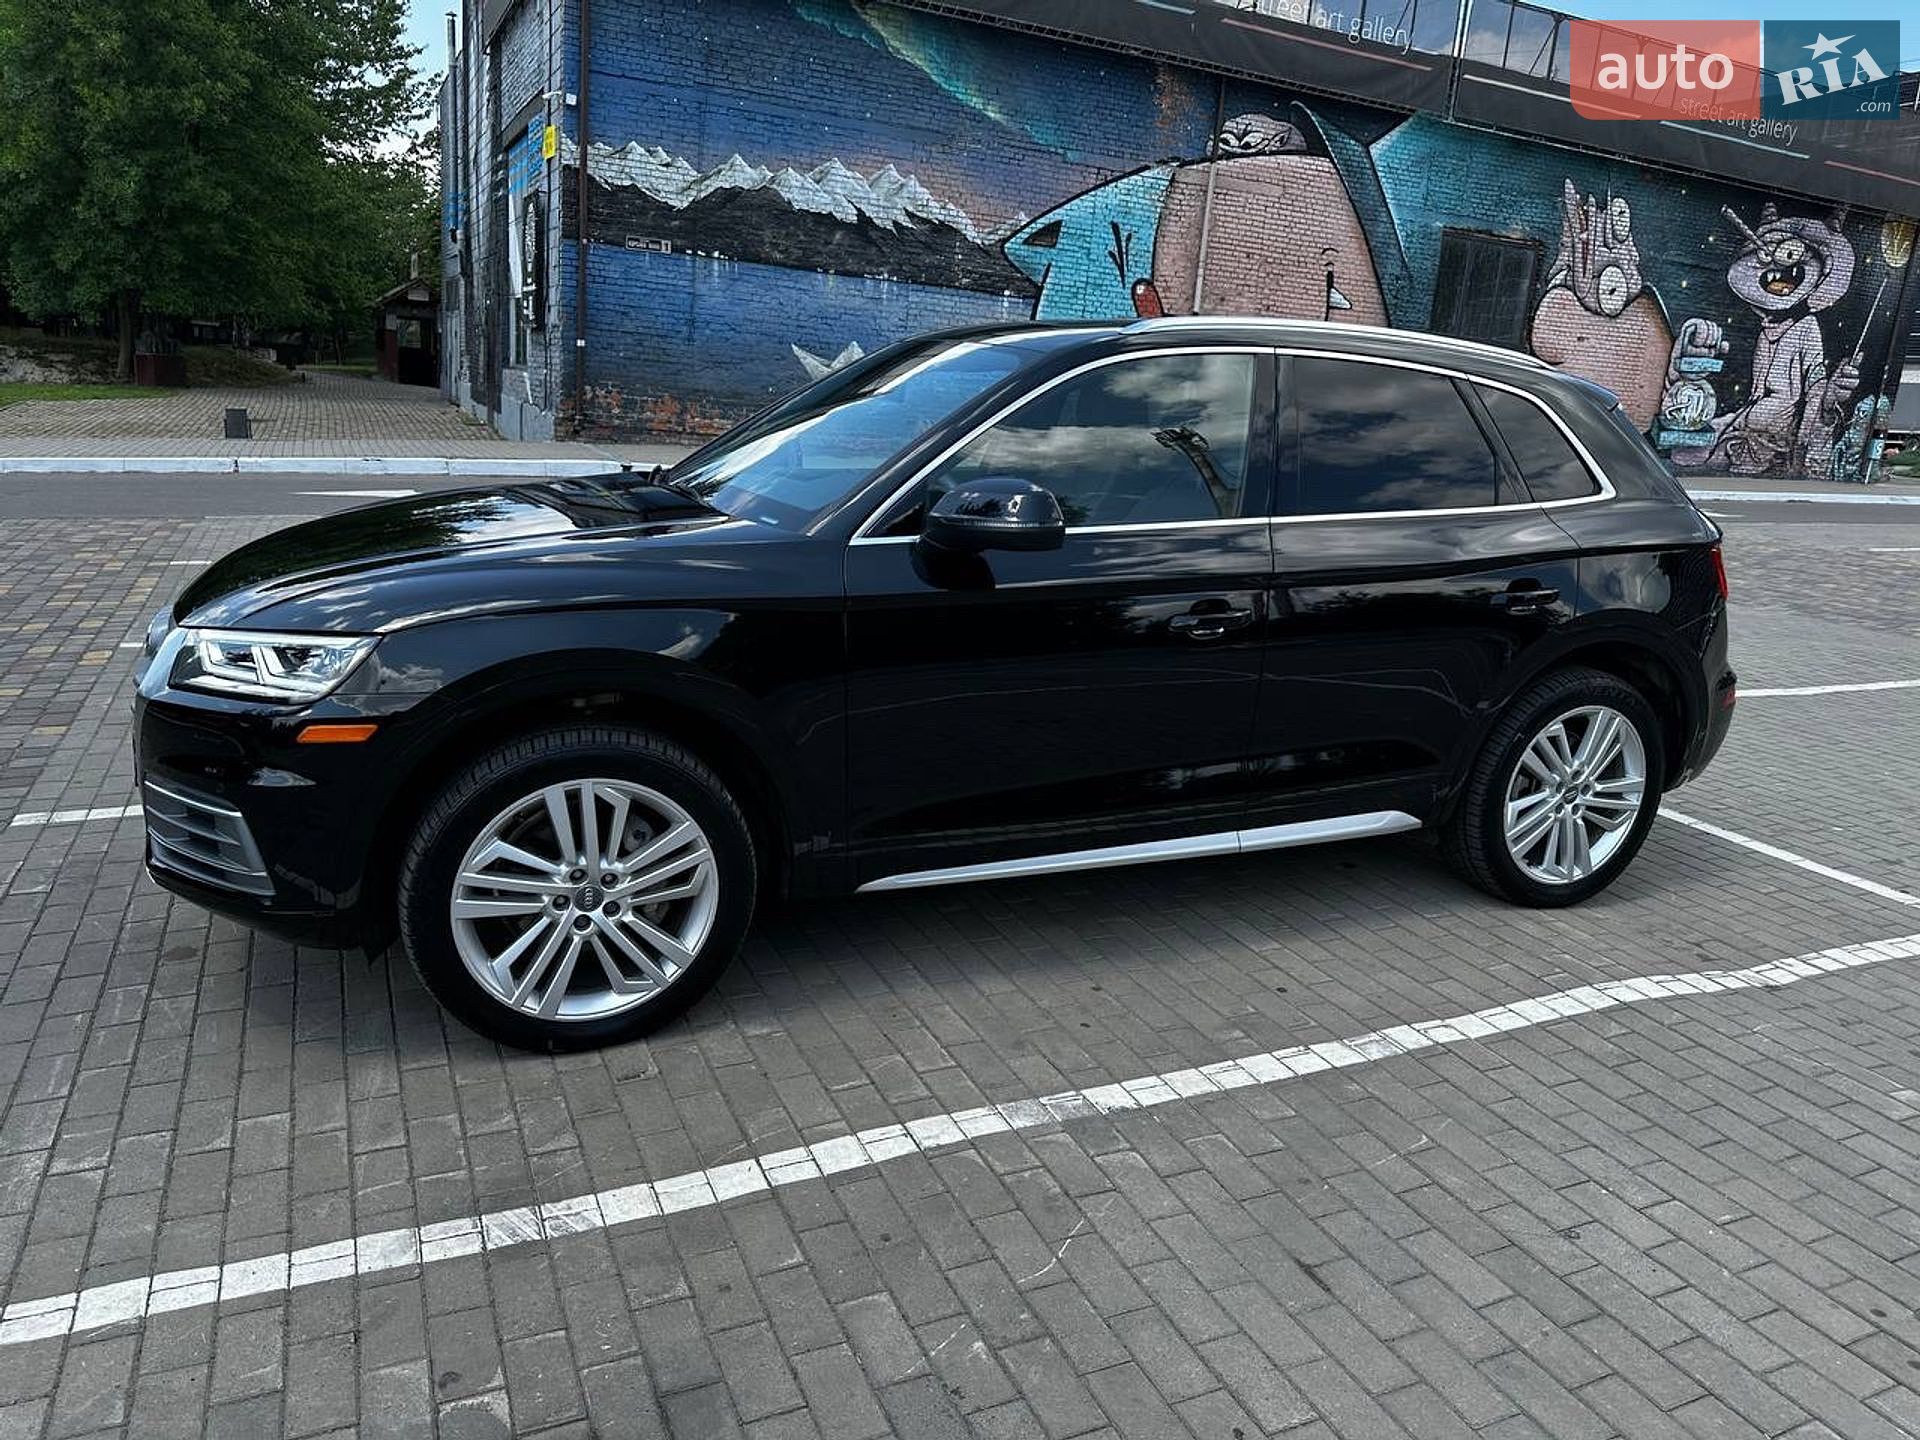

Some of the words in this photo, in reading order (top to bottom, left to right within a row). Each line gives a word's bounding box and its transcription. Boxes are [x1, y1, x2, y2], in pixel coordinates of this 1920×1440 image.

[1315, 9, 1344, 33] art
[1348, 16, 1414, 55] gallery
[1679, 97, 1723, 122] street
[1727, 109, 1748, 129] art
[1748, 116, 1798, 146] gallery
